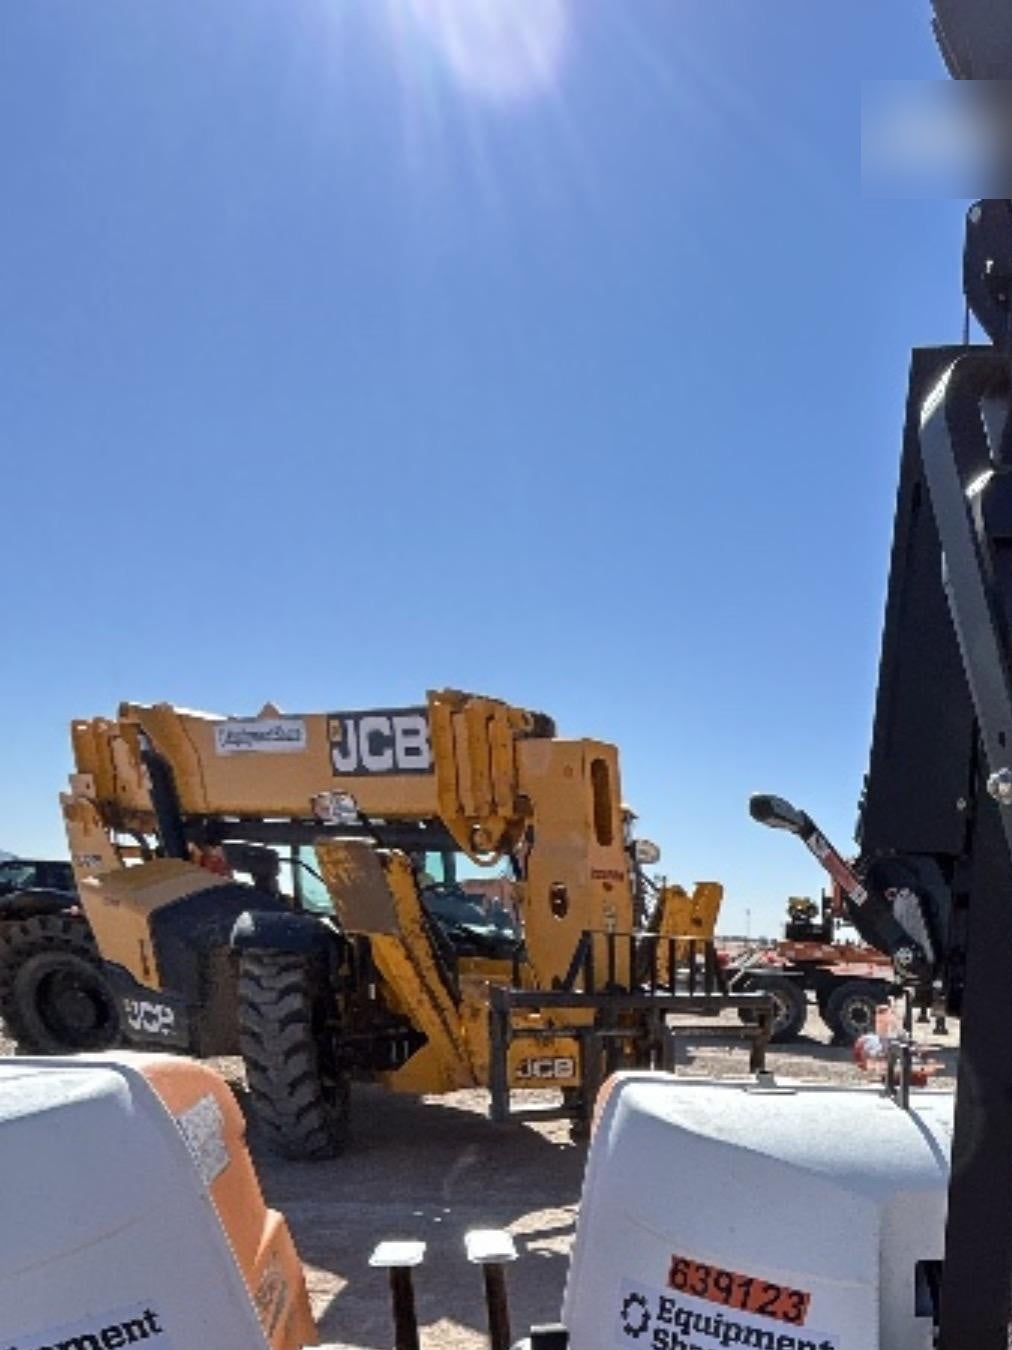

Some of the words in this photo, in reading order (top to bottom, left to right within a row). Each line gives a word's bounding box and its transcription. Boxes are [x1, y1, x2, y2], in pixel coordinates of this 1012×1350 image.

[328, 716, 432, 772] JCB
[125, 999, 176, 1036] JCB
[516, 1059, 576, 1078] JCB
[668, 1258, 807, 1323] 639123
